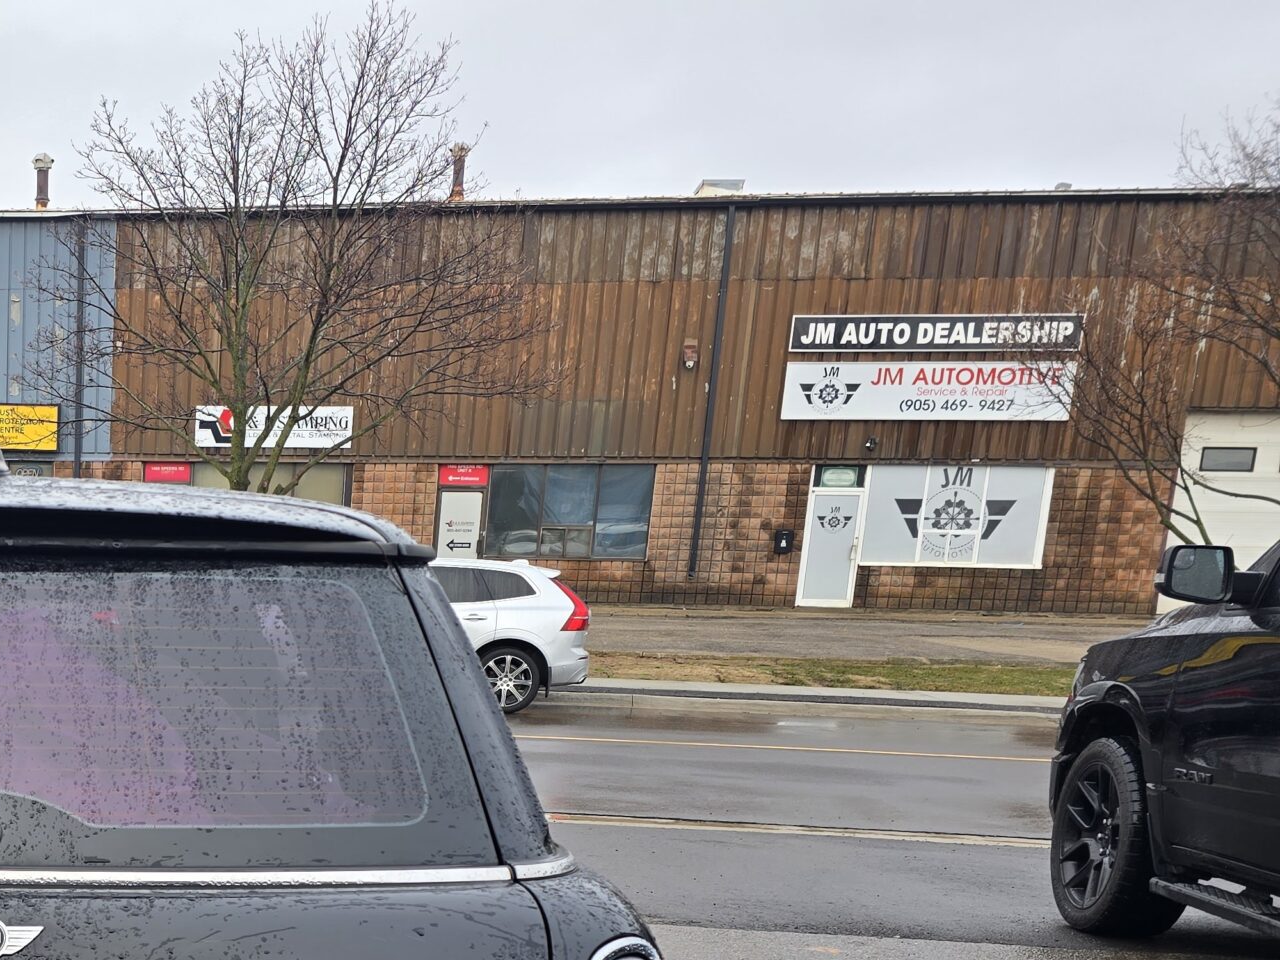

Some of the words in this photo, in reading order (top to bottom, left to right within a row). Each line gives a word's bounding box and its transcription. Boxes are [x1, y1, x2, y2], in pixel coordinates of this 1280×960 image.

[800, 322, 836, 344] JM
[840, 322, 911, 344] AUTO
[916, 321, 1074, 344] DEALERSHIP
[823, 366, 840, 378] JM
[871, 367, 904, 386] JM
[912, 367, 1064, 386] AUTOMOTIVE
[916, 387, 957, 397] Service
[960, 387, 969, 397] &
[972, 386, 1009, 399] Repair
[899, 399, 936, 412] (905)
[979, 399, 1015, 412] 9427
[16, 468, 39, 477] OPEN
[941, 466, 973, 488] JM
[1174, 767, 1213, 785] RAM
